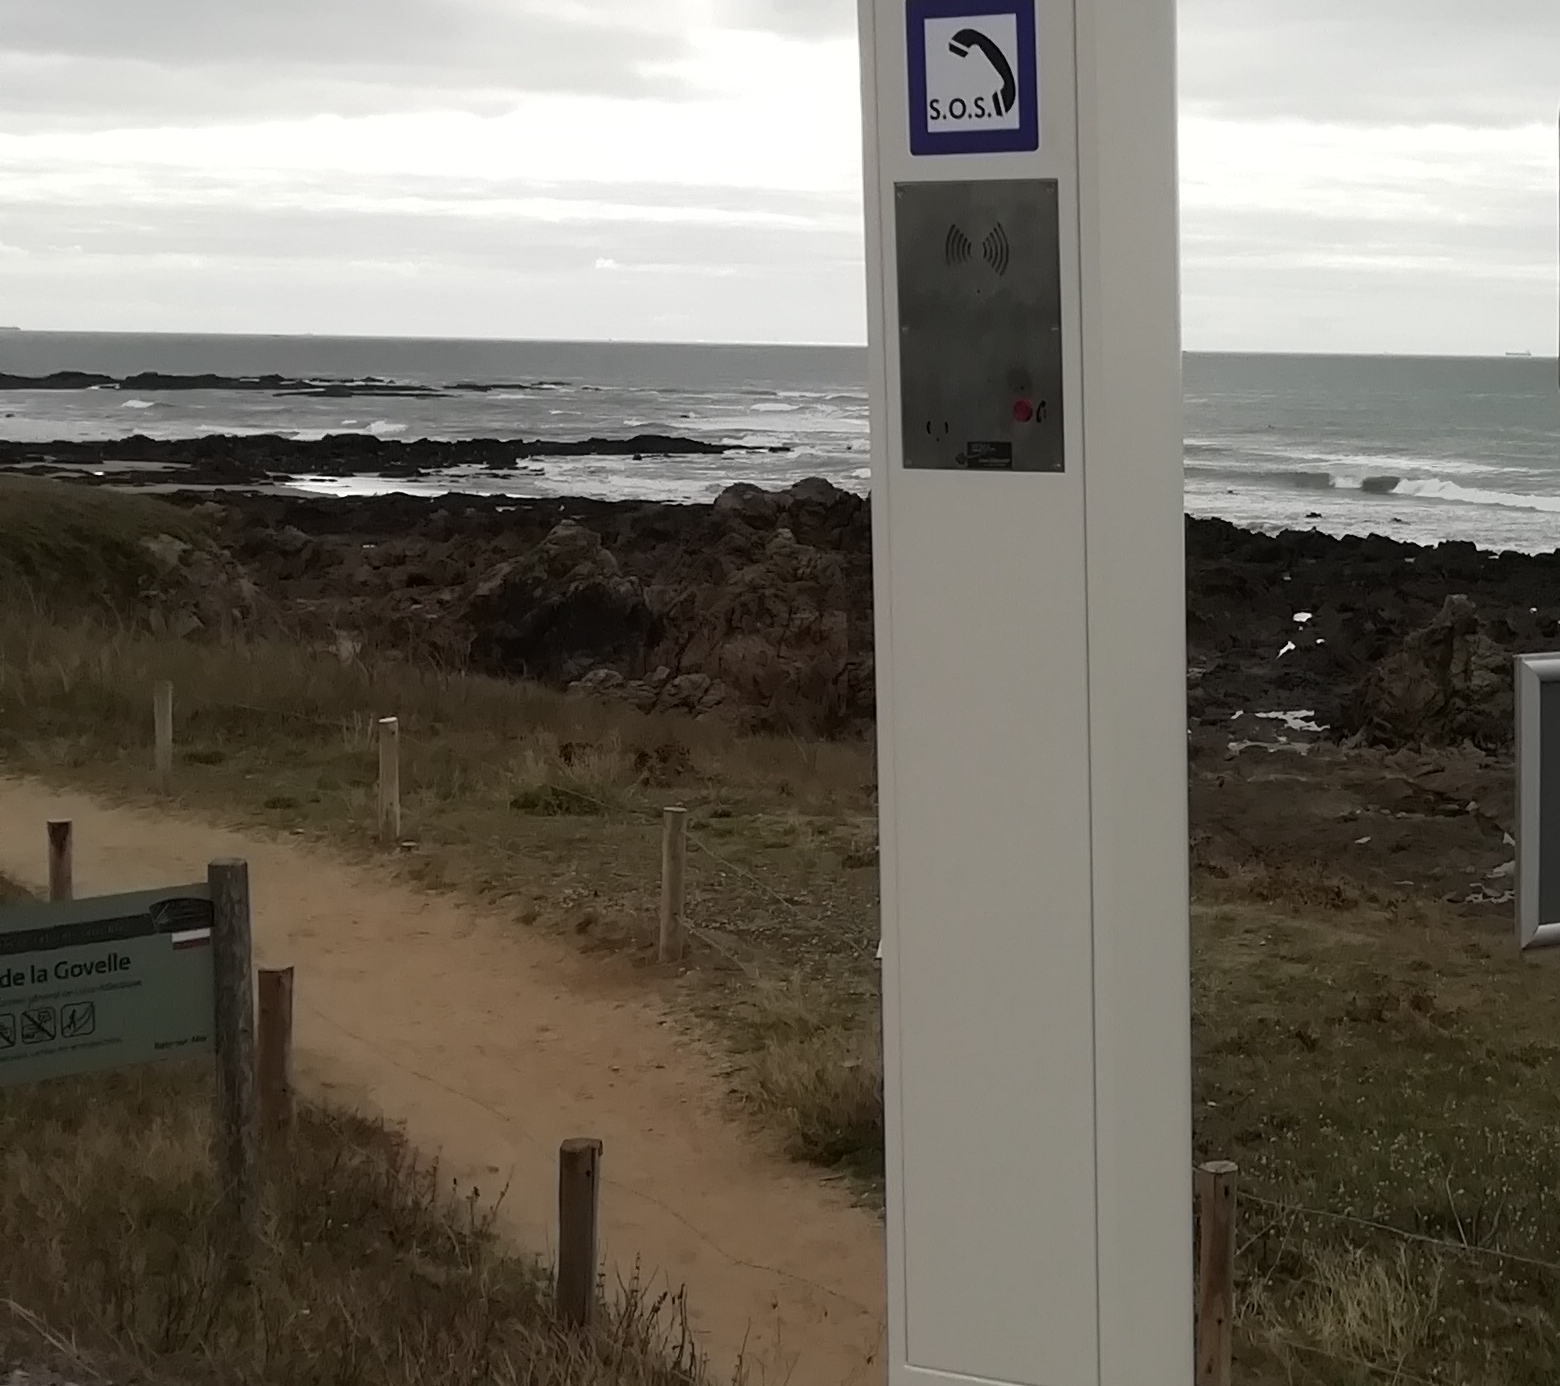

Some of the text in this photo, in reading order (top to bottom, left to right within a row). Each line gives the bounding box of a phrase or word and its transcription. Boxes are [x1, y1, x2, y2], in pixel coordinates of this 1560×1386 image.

[929, 96, 992, 120] S.O.S.
[0, 952, 132, 988] de la Govelle
